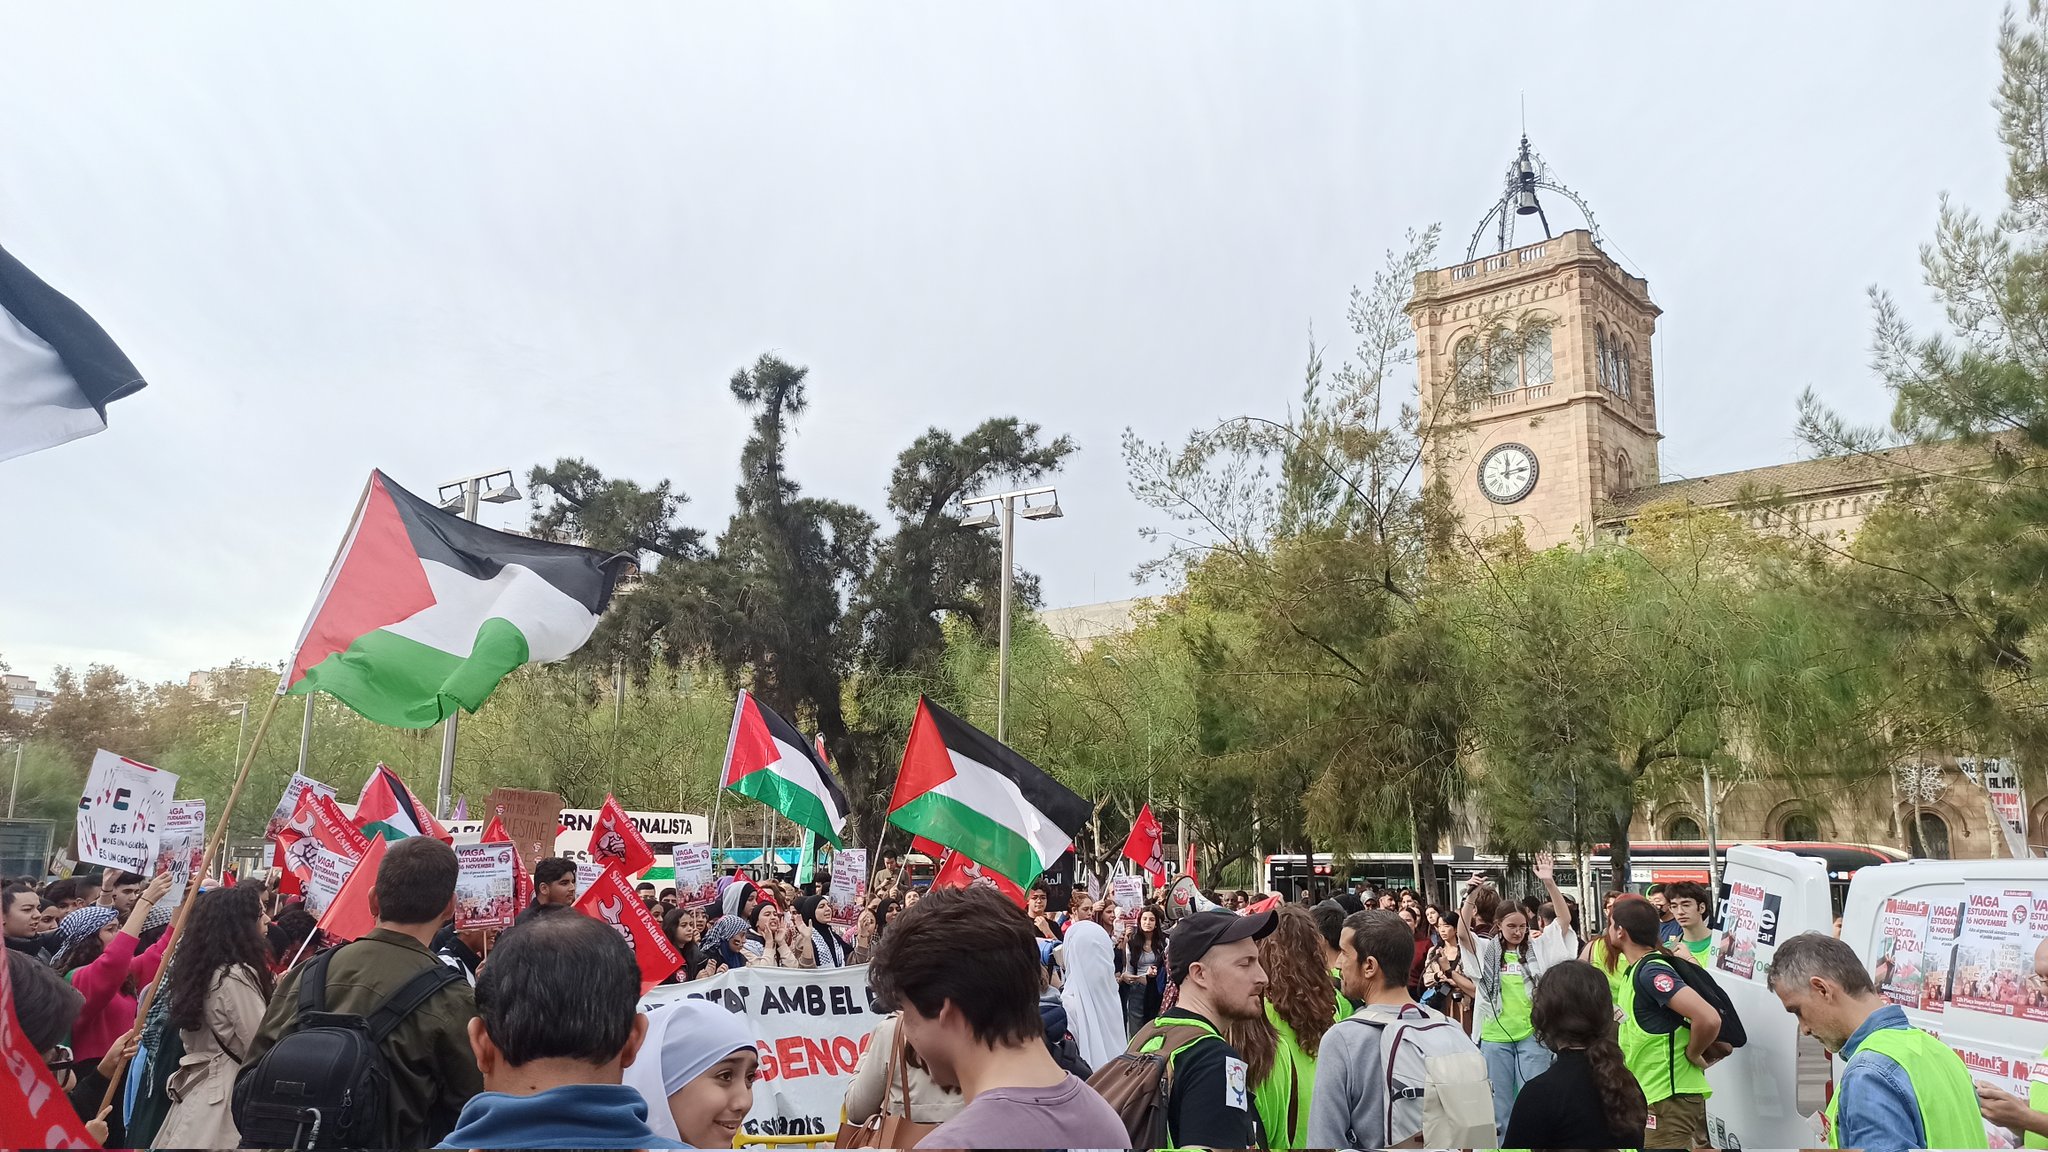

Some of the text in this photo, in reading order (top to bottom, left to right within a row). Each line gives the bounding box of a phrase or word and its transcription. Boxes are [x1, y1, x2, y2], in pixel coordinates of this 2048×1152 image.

[503, 818, 548, 841] ALESTINE
[329, 826, 362, 862] d'Estudi
[458, 848, 486, 857] VAGA
[675, 848, 694, 857] VAGA
[317, 856, 335, 870] VAGA
[1969, 894, 1999, 908] VAGA
[609, 870, 678, 964] Sindicat d'Estudiants
[1933, 905, 1958, 918] VAGA
[1967, 907, 2009, 920] ESTUDIANTIL
[1883, 916, 1900, 926] ALTO
[1966, 917, 2008, 928] 16 NOVEMBRE
[1883, 926, 1913, 938] GENOCIDI
[1895, 938, 1923, 954] GAZA!
[760, 985, 827, 1016] AMB
[828, 985, 864, 1016] EL
